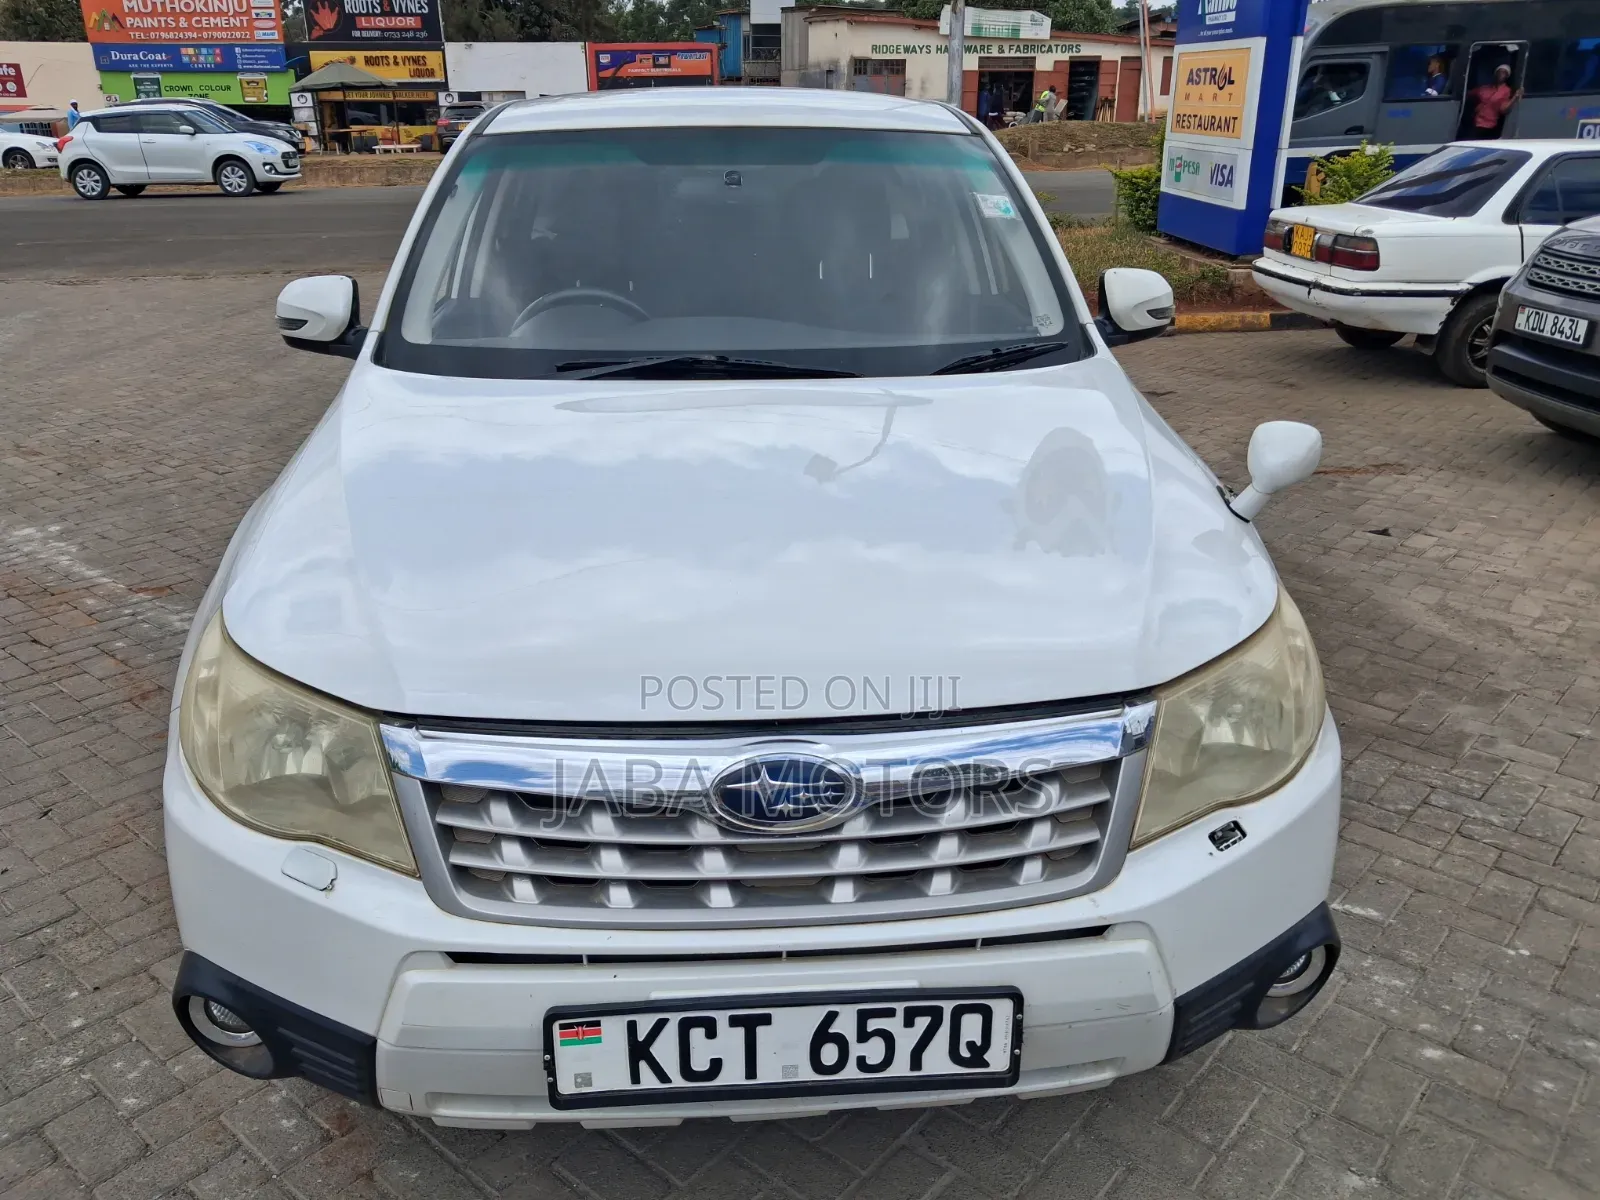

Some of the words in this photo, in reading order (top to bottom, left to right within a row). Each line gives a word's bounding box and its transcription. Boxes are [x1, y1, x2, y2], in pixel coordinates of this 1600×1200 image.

[122, 0, 247, 15] MUTHOKINJU
[344, 0, 381, 13] ROOTS
[383, 0, 390, 11] &
[392, 0, 429, 13] VYNES
[125, 17, 176, 28] PAINTS
[179, 17, 188, 27] &
[192, 17, 249, 28] CEMENT
[361, 17, 416, 27] LIQUOR
[871, 44, 932, 54] RIDGEWAYS
[936, 44, 993, 54] HAWARE
[998, 44, 1005, 54] &
[1008, 43, 1081, 54] FABRICATORS
[364, 55, 390, 66] ROOTS
[393, 55, 399, 66] &
[401, 55, 427, 66] VYNES
[409, 68, 435, 78] LIQUOR
[1185, 92, 1233, 102] MART
[1176, 113, 1238, 133] RESTAURANT
[1209, 163, 1234, 188] VISA
[1524, 308, 1548, 334] KDU
[1549, 315, 1581, 342] 843L
[626, 1012, 772, 1085] KCT
[809, 1002, 994, 1076] 657Q
